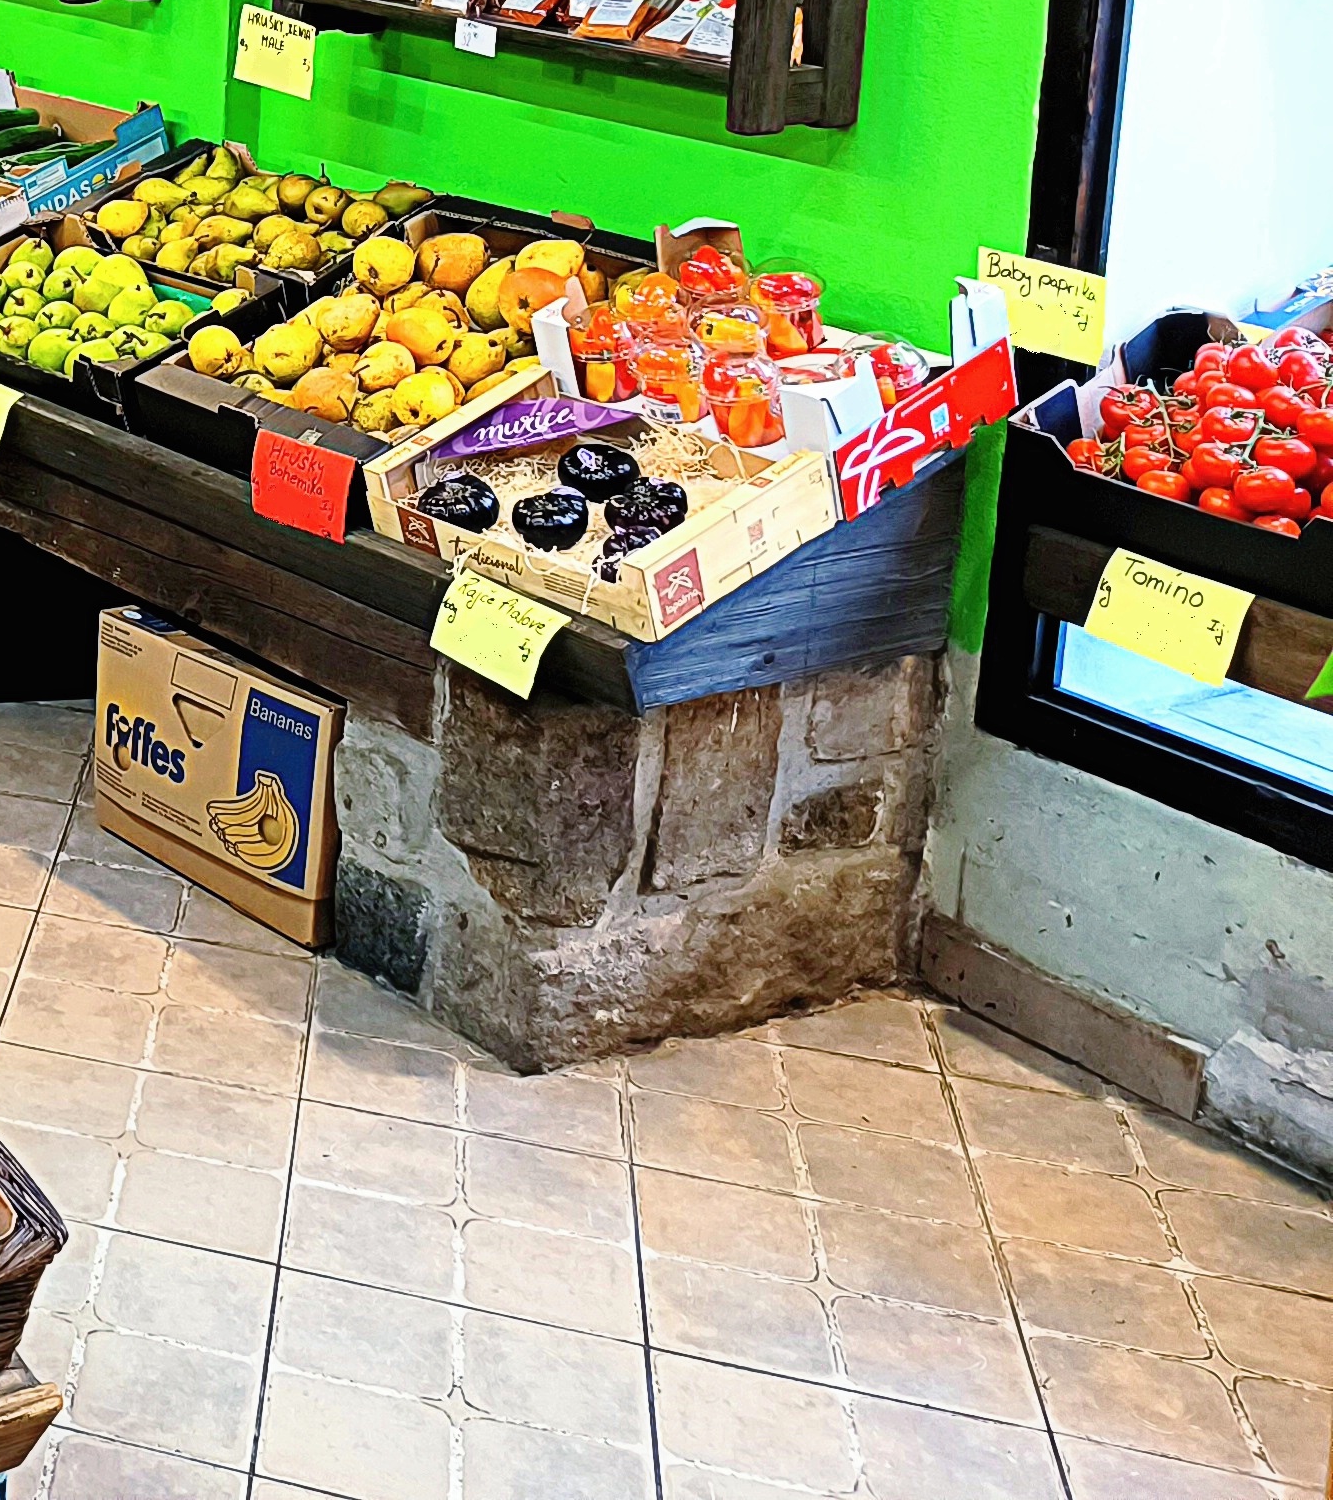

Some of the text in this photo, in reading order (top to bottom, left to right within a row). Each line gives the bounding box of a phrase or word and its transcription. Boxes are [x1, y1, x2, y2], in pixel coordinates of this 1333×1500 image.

[987, 252, 1096, 302] Baby paprika
[269, 439, 325, 484] Hrušky
[249, 698, 313, 741] Bananas
